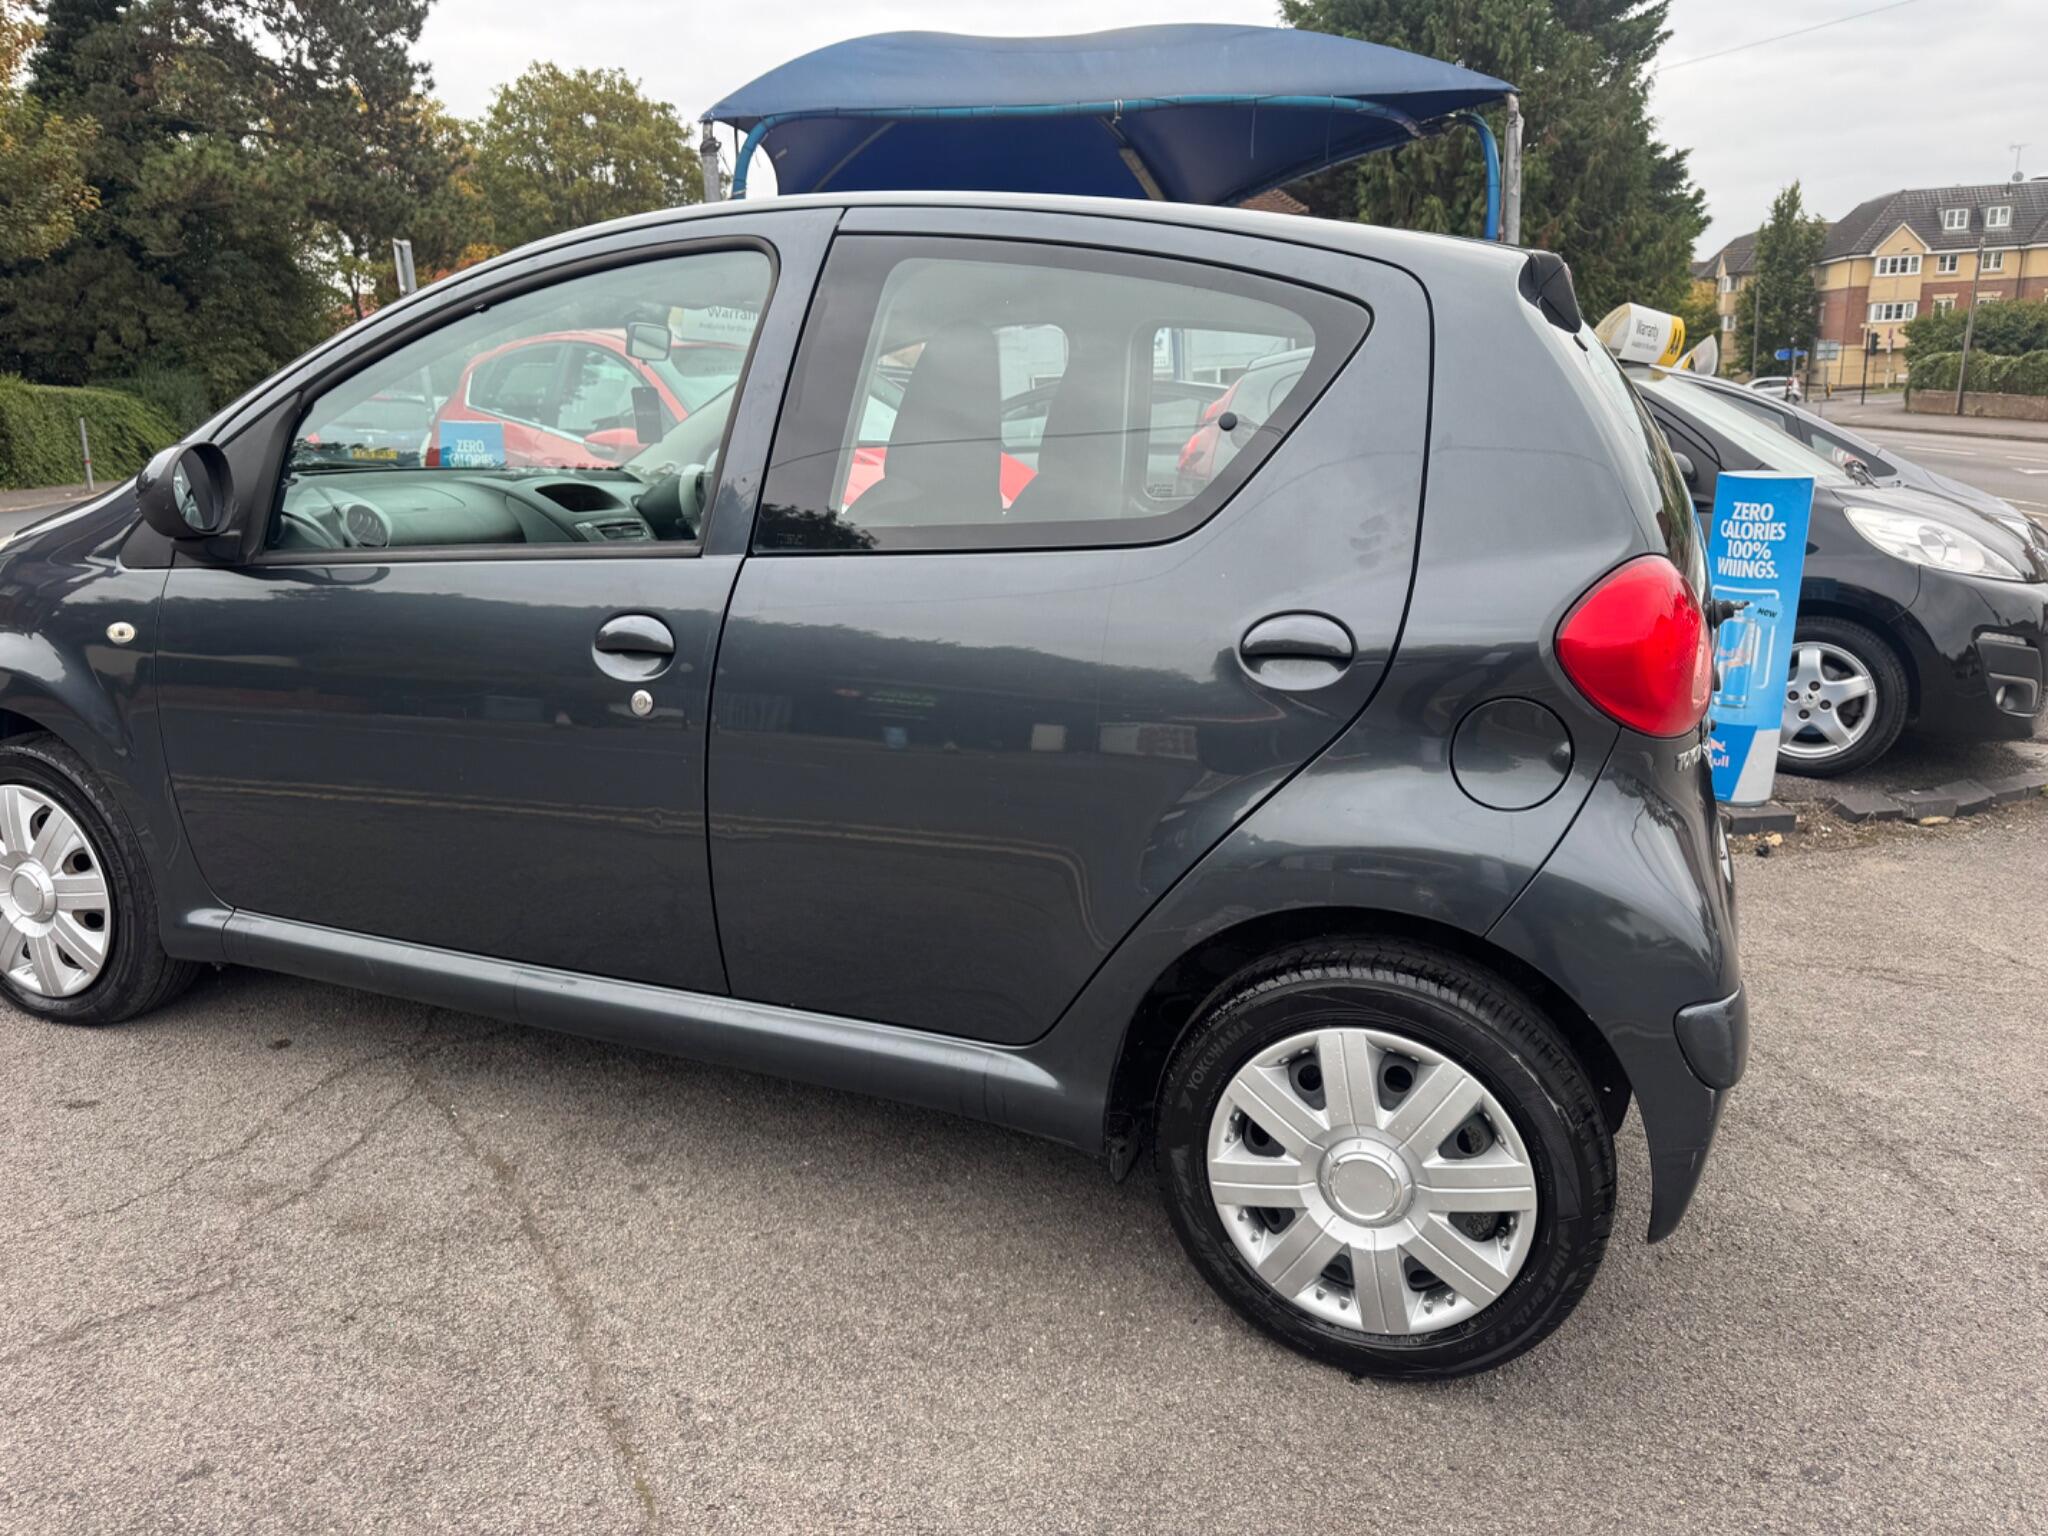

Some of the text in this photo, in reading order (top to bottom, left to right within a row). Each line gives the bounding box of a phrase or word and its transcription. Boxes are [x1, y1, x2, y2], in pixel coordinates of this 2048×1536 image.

[456, 440, 485, 453] ZERO
[1731, 501, 1775, 521] ZERO
[1720, 519, 1787, 541] CALORIES
[1726, 539, 1772, 560] 100%
[1717, 556, 1779, 579] WIIINGS.
[1712, 754, 1730, 768] ull
[1186, 1020, 1254, 1091] YOKOHAMA
